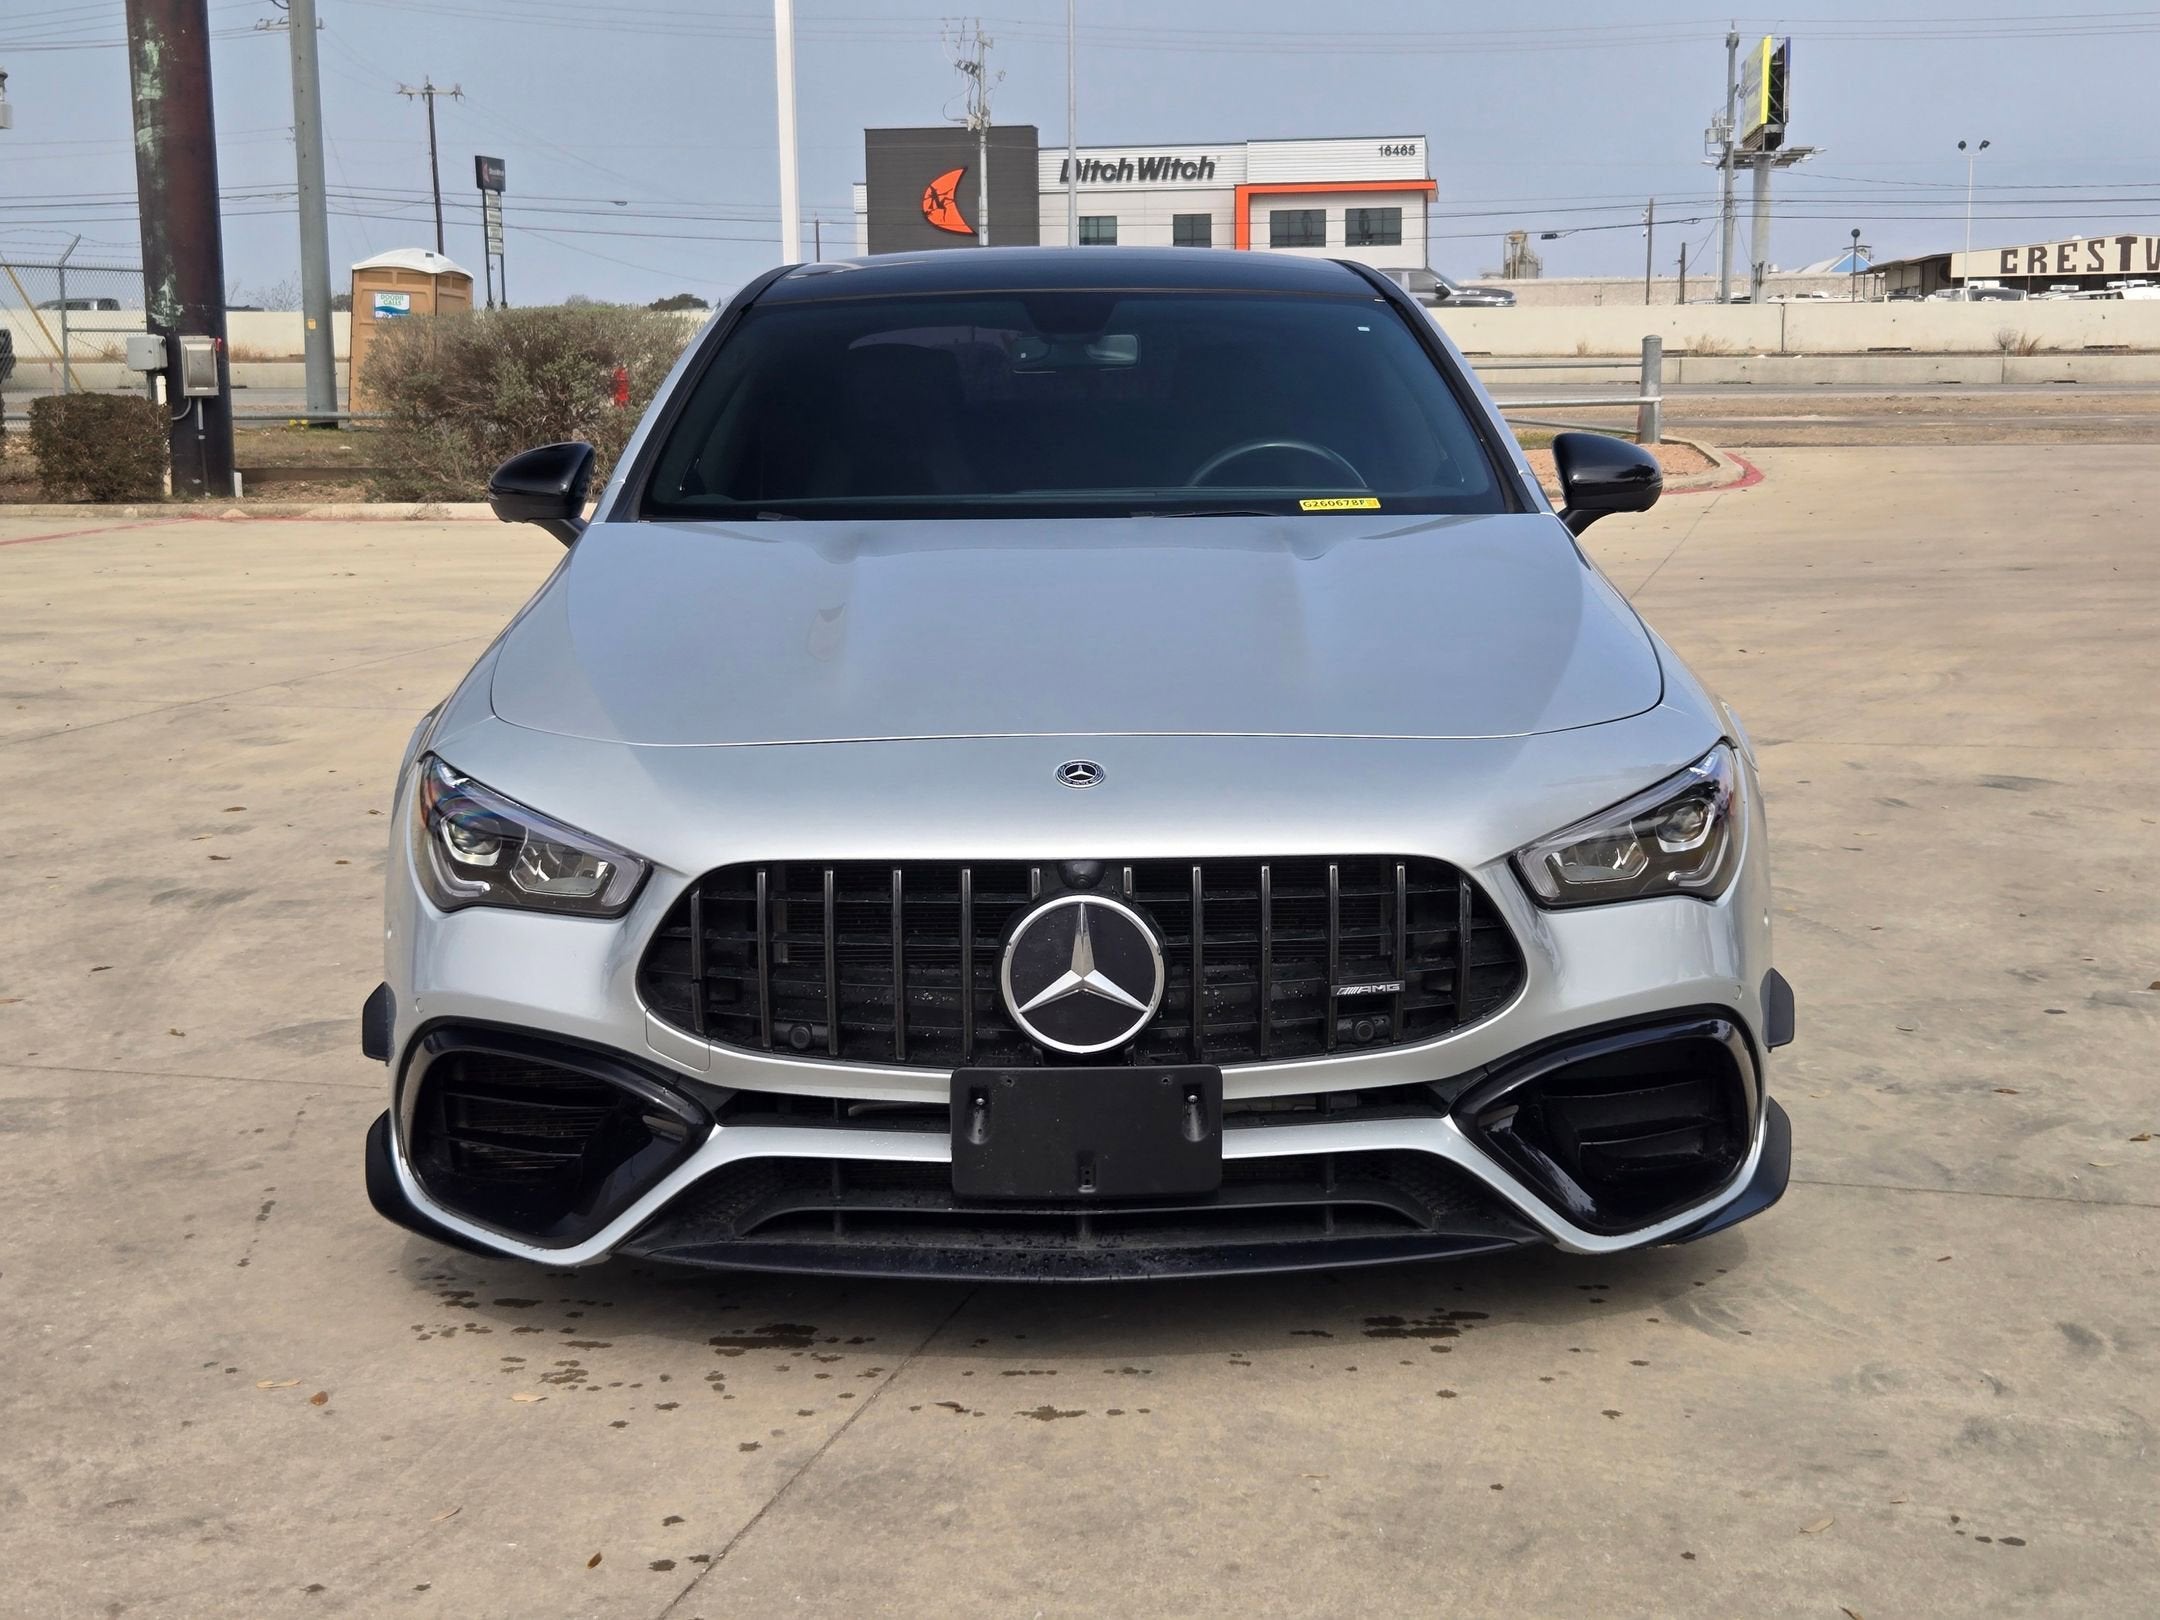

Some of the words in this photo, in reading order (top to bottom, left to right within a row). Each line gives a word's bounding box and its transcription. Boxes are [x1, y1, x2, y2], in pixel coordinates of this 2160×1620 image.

[1378, 144, 1416, 157] 16465
[1059, 157, 1134, 184] Ditch
[1138, 155, 1215, 182] Witch
[1356, 983, 1401, 995] AMG
